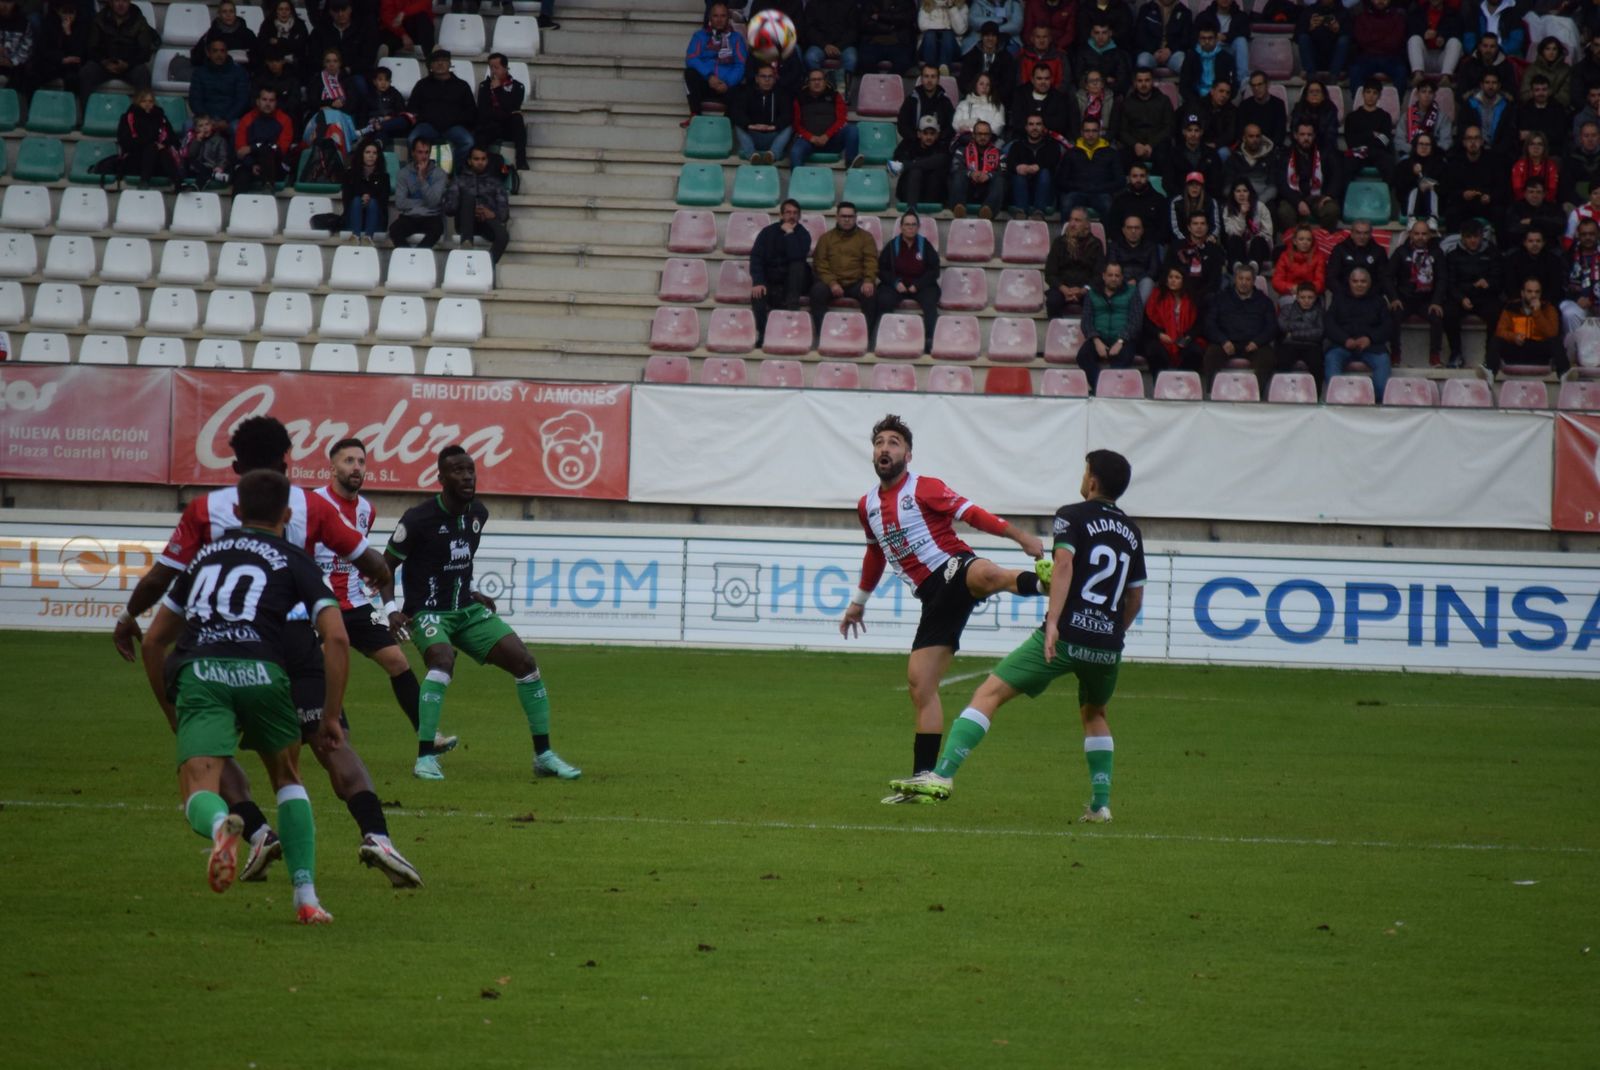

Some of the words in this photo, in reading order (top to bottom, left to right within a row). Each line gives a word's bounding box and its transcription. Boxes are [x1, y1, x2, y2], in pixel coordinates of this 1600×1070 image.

[411, 383, 513, 401] EMBUTIDOS
[518, 387, 530, 401] Y
[534, 388, 617, 406] JAMONES
[9, 427, 60, 440] NUEVA
[65, 427, 149, 442] UBICACIÓN
[8, 444, 48, 458] Plaza
[53, 445, 106, 459] Cuartel
[111, 447, 148, 462] Viejo
[317, 468, 331, 480] de
[1086, 519, 1139, 550] ALDASORO
[234, 537, 288, 571] GARCÍA
[525, 557, 659, 609] HGM
[1081, 545, 1130, 612] 21
[184, 564, 267, 622] 40
[1071, 613, 1114, 633] PASTOR
[193, 660, 272, 688] CAMARSA
